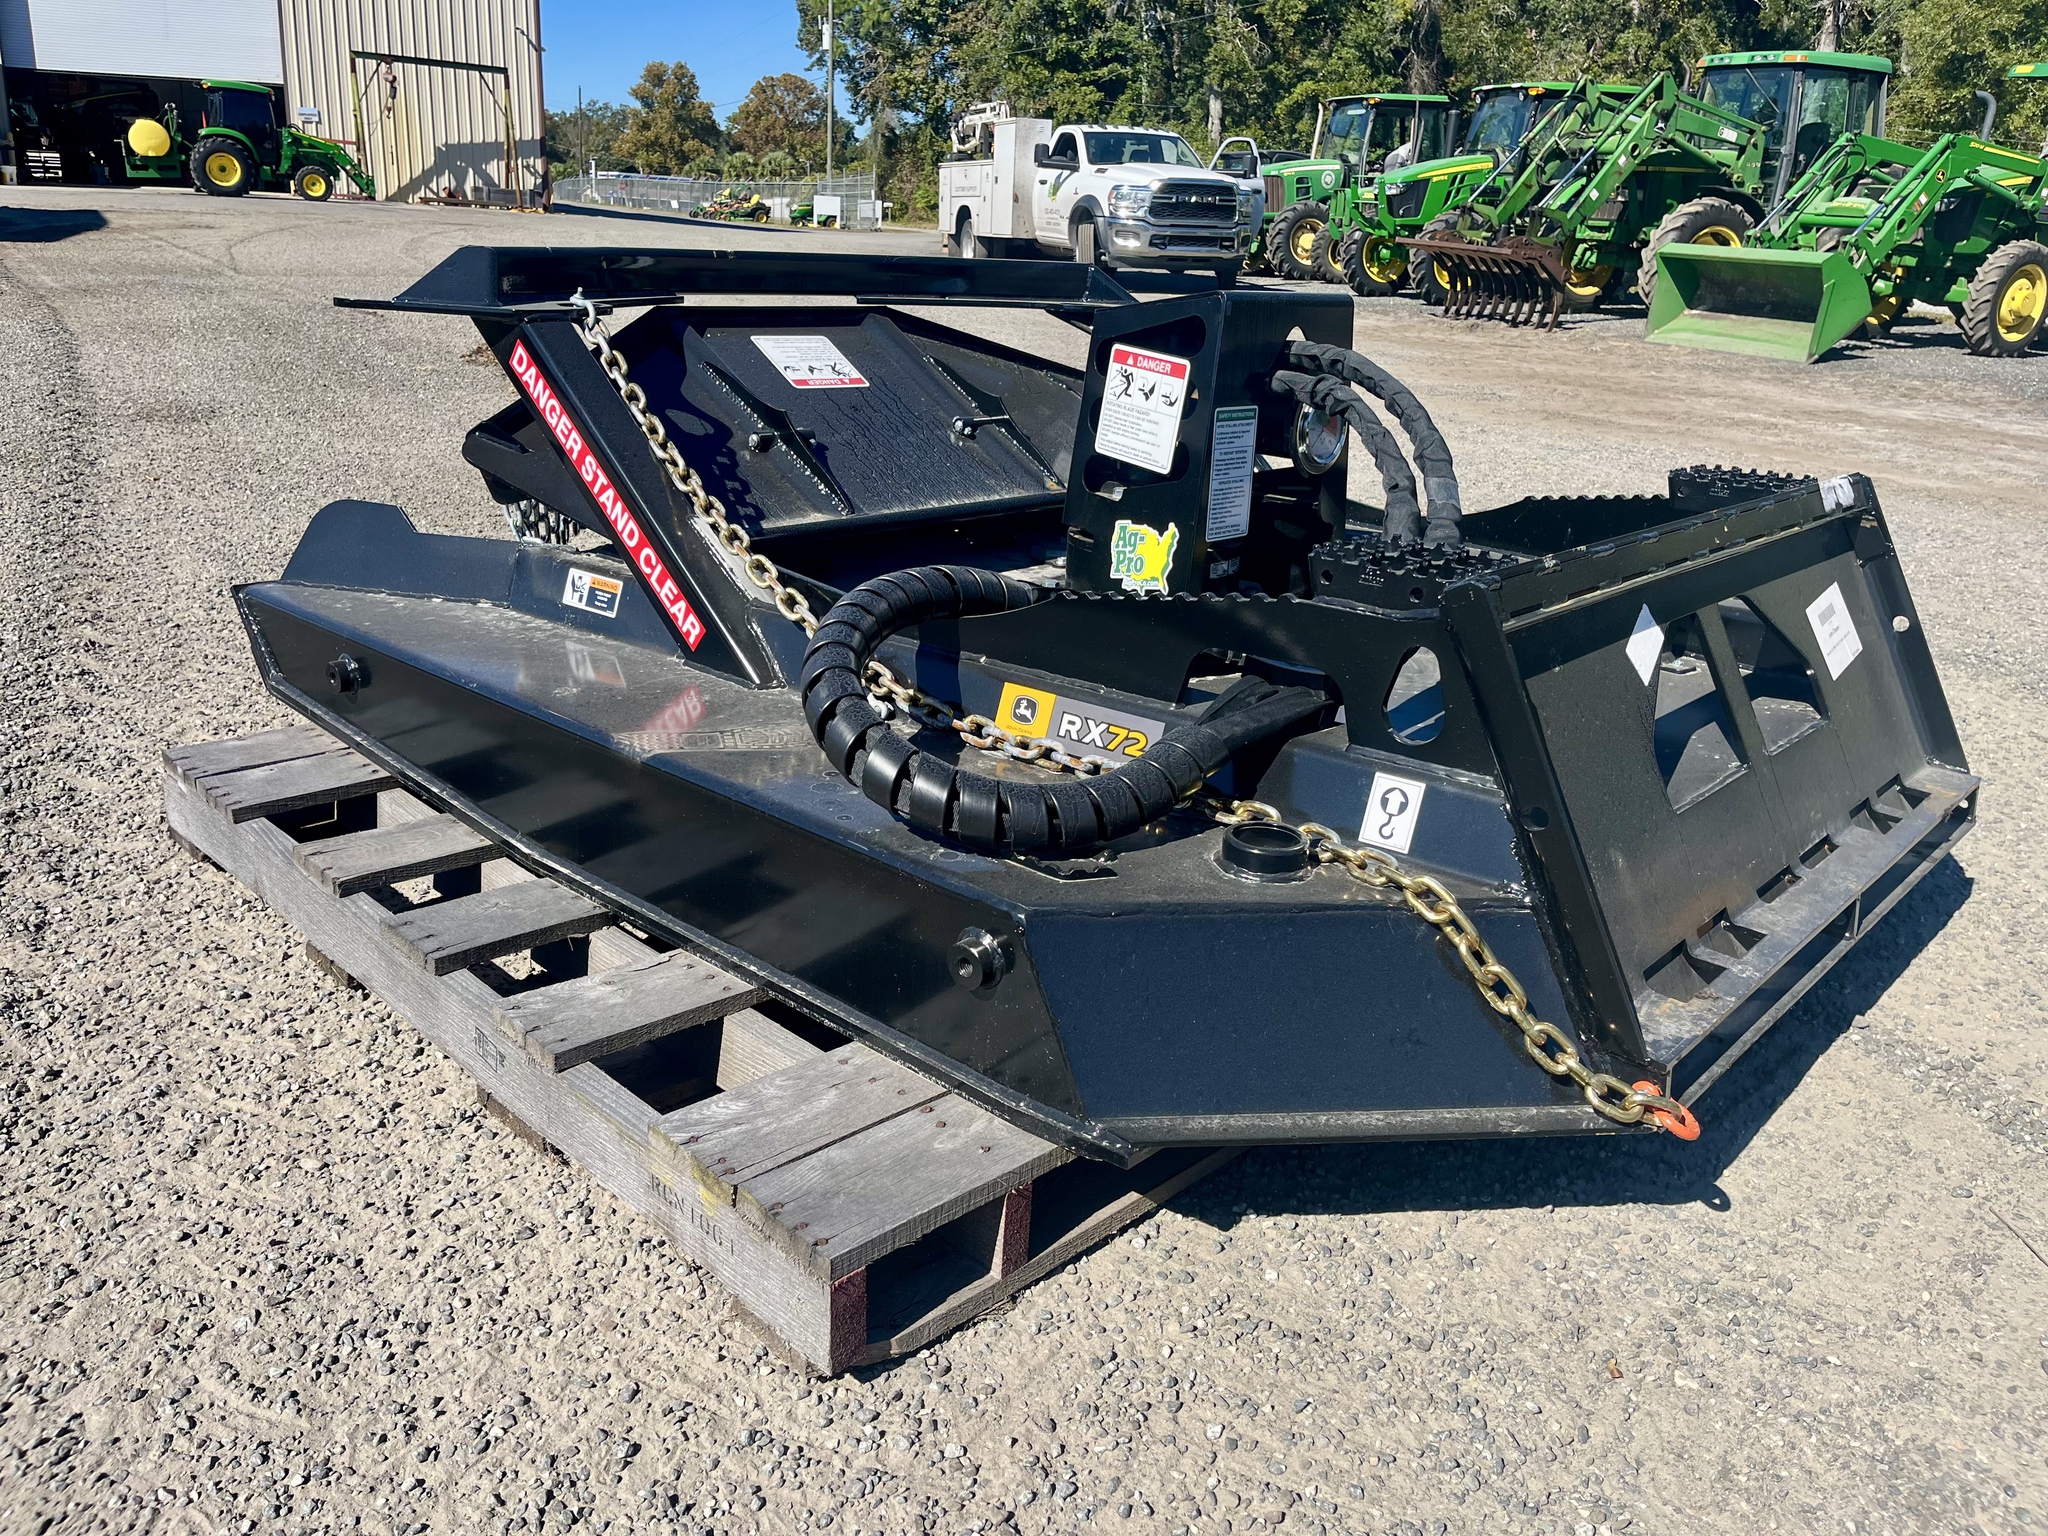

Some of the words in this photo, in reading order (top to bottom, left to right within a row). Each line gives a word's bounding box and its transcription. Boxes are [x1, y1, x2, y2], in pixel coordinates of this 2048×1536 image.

[1178, 195, 1215, 204] RAM
[1136, 356, 1171, 374] DANGER
[514, 347, 582, 459] DANGER
[581, 455, 639, 547] STAND
[639, 548, 703, 643] CLEAR
[1114, 550, 1145, 574] Pro
[596, 579, 618, 590] WARNING
[1057, 711, 1149, 759] RX72
